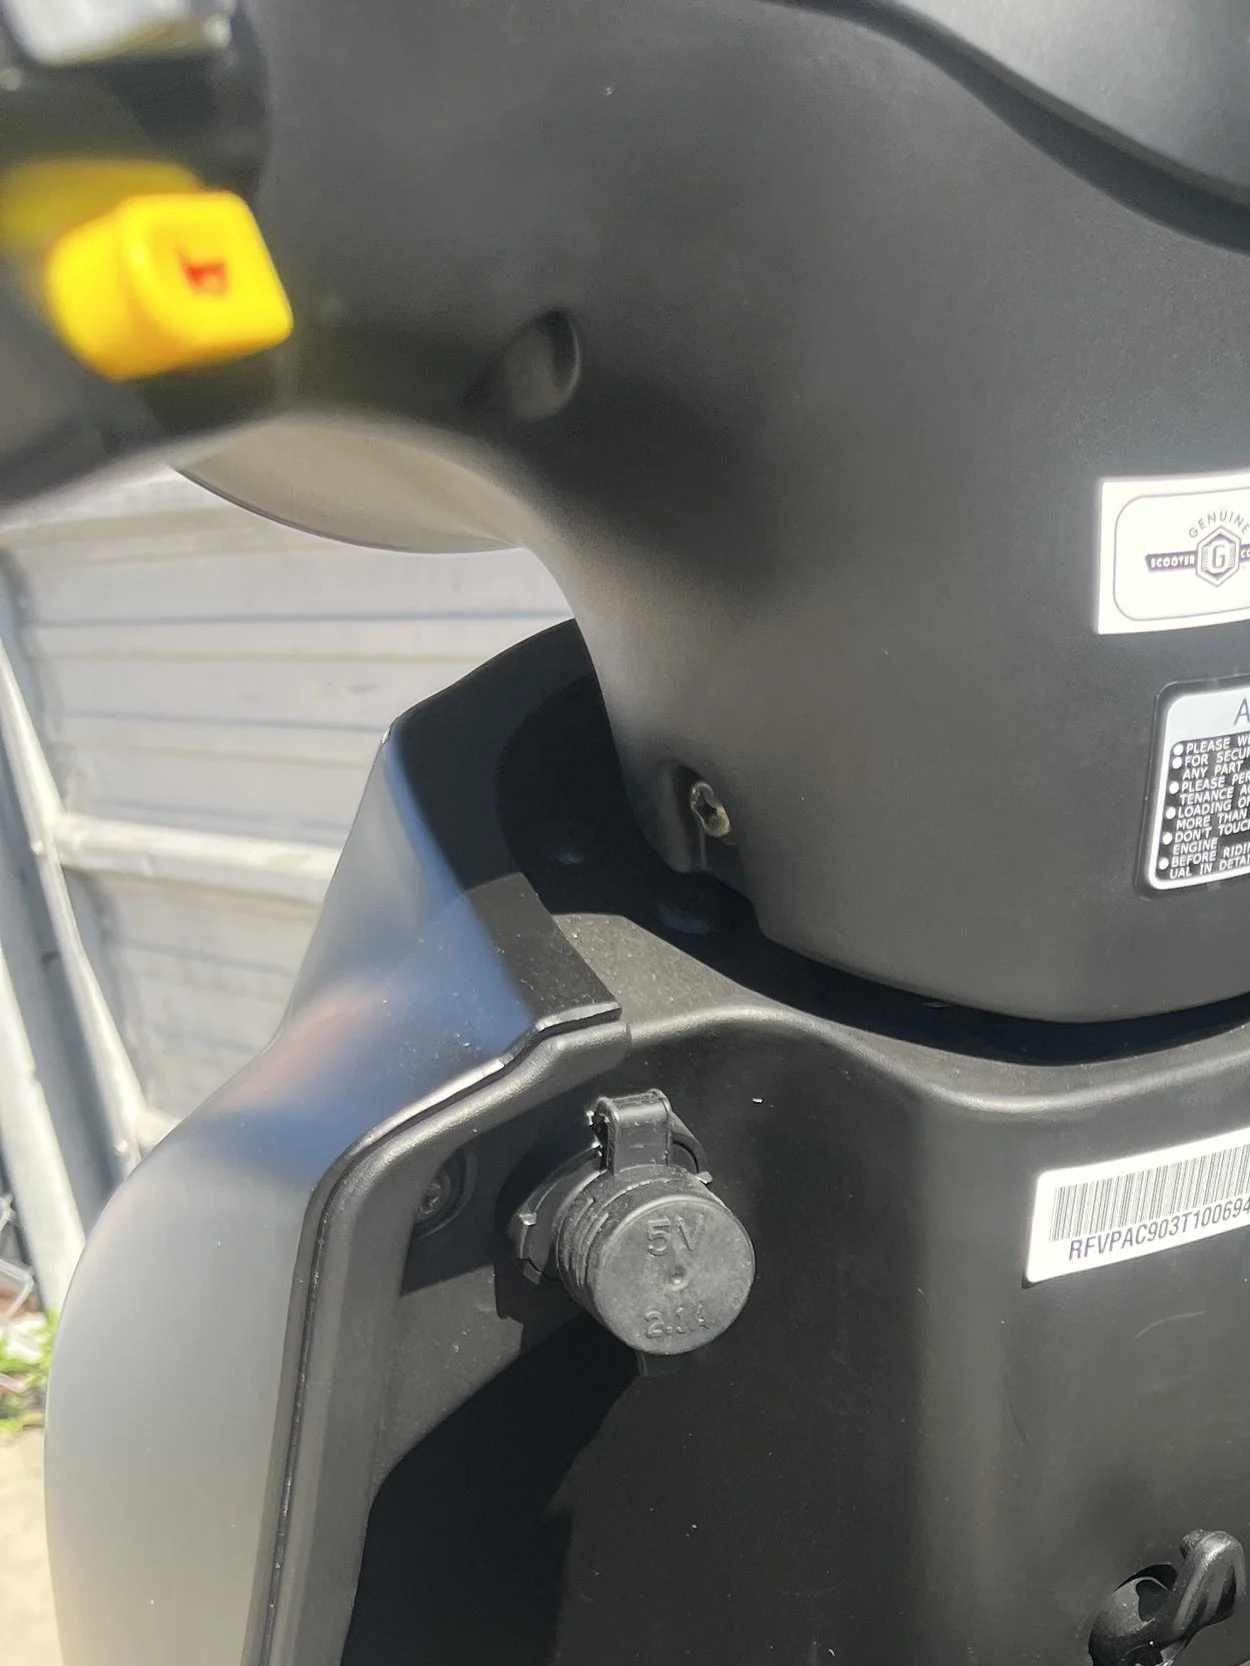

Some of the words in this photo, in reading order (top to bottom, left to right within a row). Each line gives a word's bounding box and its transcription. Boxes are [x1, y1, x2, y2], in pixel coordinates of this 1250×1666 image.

[1188, 510, 1250, 539] GENUINE
[1150, 555, 1196, 568] SCOOTER
[1212, 544, 1226, 569] G
[1186, 737, 1231, 754] PLEASE
[1185, 754, 1209, 768] FOR
[1182, 767, 1208, 780] ANY
[1214, 761, 1243, 776] PART
[1182, 776, 1226, 793] PLEASE
[1180, 786, 1235, 805] TENANCE
[1178, 800, 1232, 819] LOADING
[1176, 815, 1211, 831] MORE
[1218, 808, 1247, 824] THAN
[1175, 827, 1212, 843] DON'T
[1173, 837, 1218, 855] ENGINE
[1172, 850, 1217, 868] BEFORE
[1170, 867, 1192, 879] UAL
[1200, 863, 1213, 875] IN
